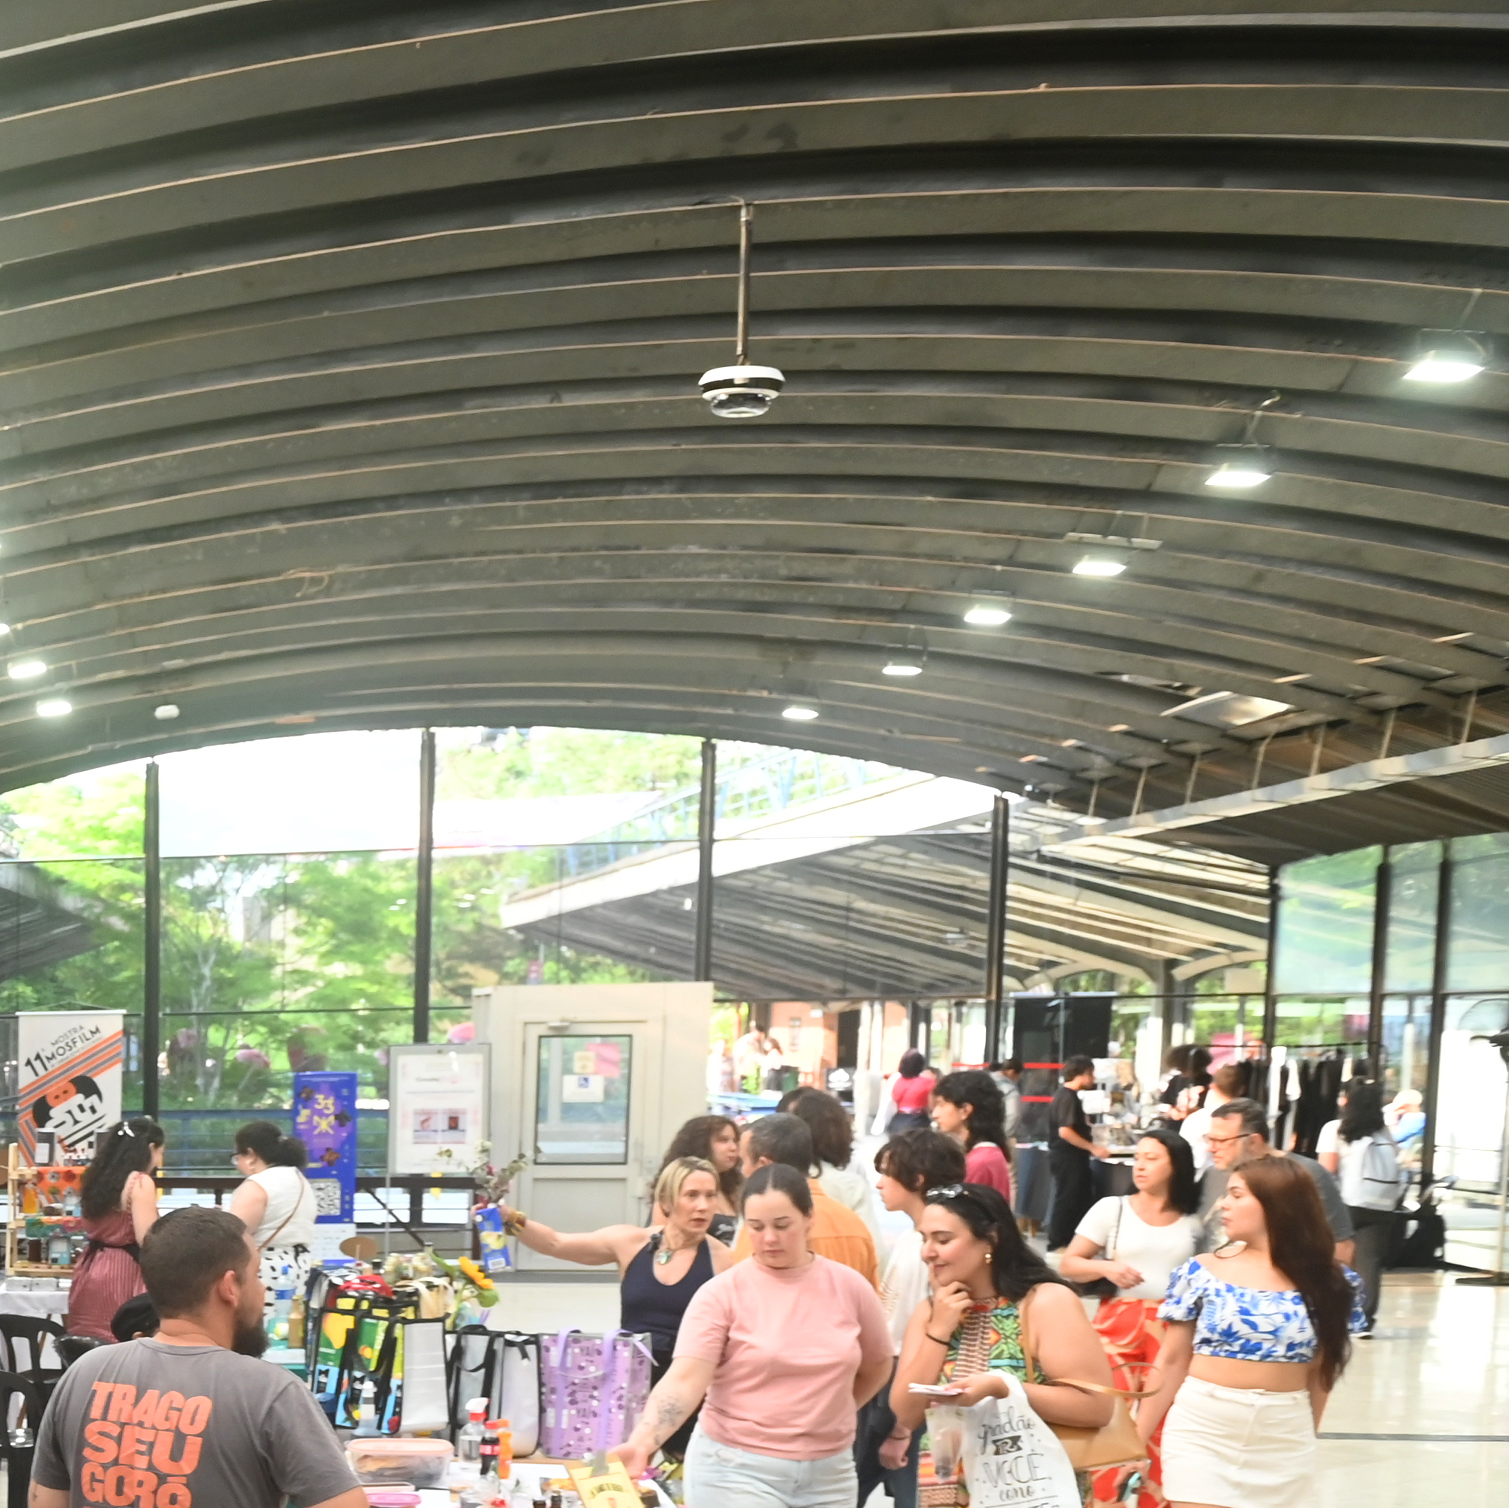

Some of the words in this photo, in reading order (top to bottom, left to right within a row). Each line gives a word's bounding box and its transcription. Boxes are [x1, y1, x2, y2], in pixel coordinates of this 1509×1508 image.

[45, 1025, 101, 1064] MOSFILM
[51, 1025, 85, 1046] MOSTRA
[89, 1381, 213, 1435] TRAGO
[82, 1420, 203, 1475] SEU
